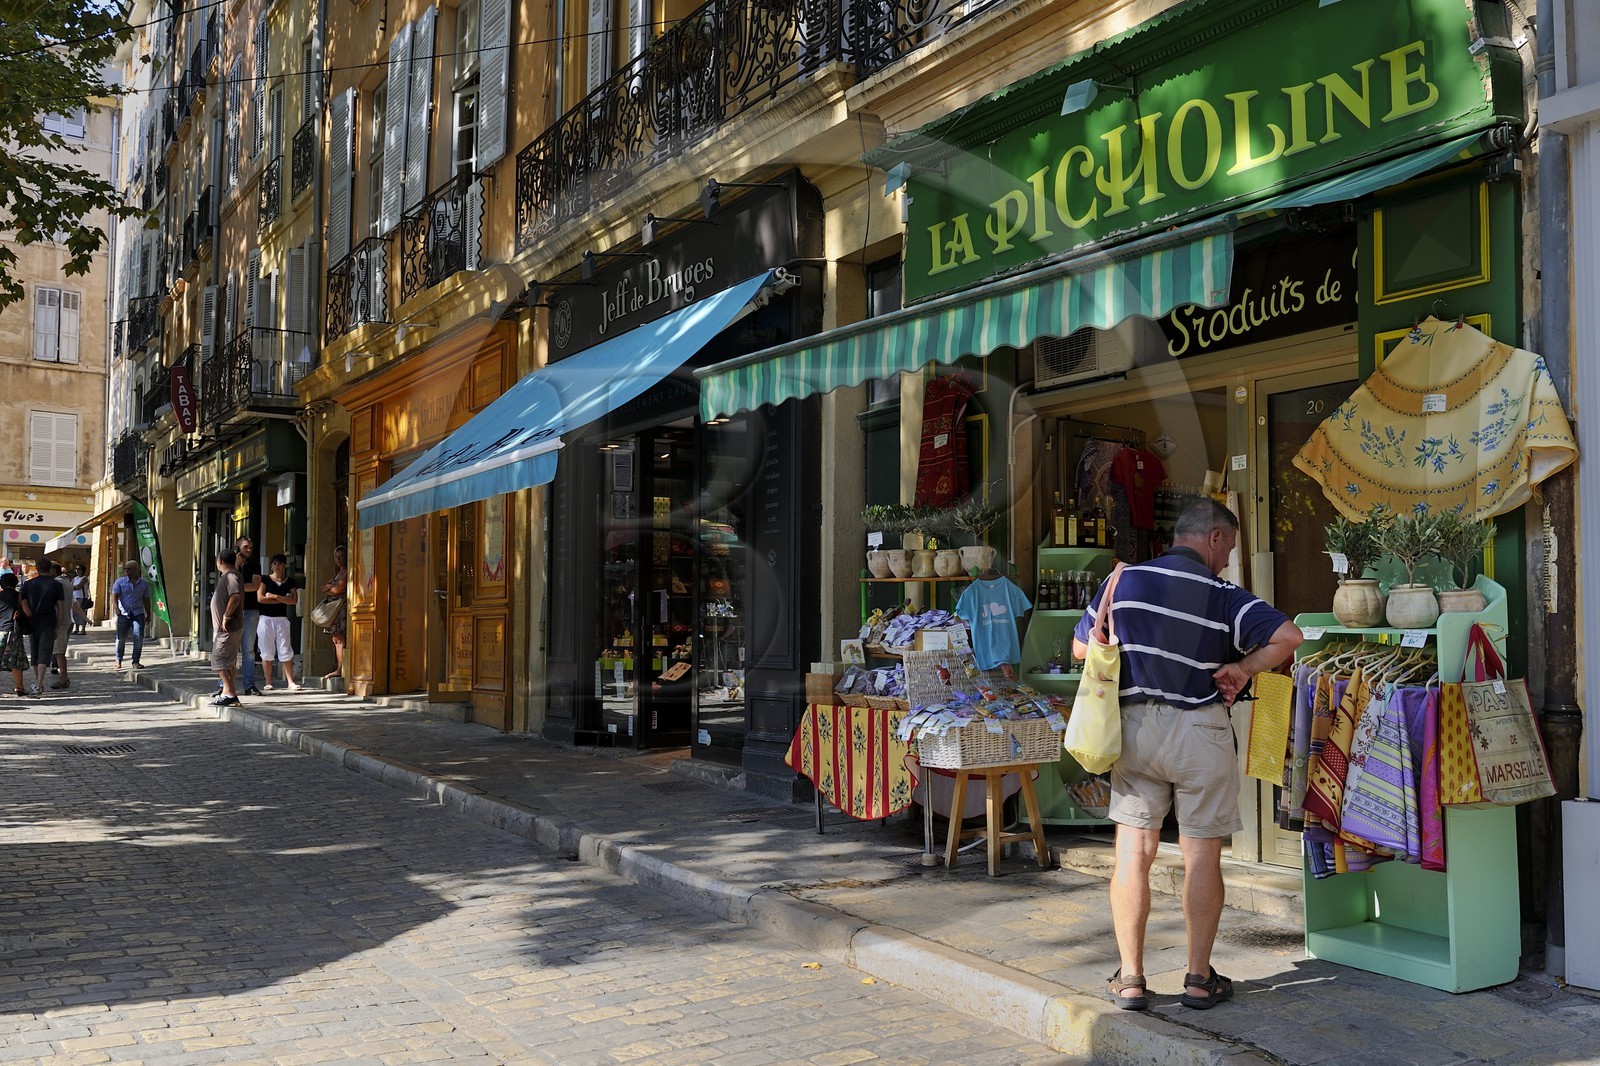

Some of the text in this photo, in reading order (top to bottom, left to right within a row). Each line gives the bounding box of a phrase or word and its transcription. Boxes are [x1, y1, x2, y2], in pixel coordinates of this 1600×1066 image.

[926, 39, 1440, 276] LA PICHOLINE
[598, 277, 630, 335] Jeff
[630, 286, 644, 312] de
[645, 256, 715, 302] Bruges
[1315, 268, 1342, 305] de
[176, 375, 192, 426] TABAC
[1306, 399, 1324, 415] 20
[395, 521, 407, 681] BISCUITIER
[1509, 734, 1518, 745] DE
[1485, 759, 1545, 784] MARSEILLE
